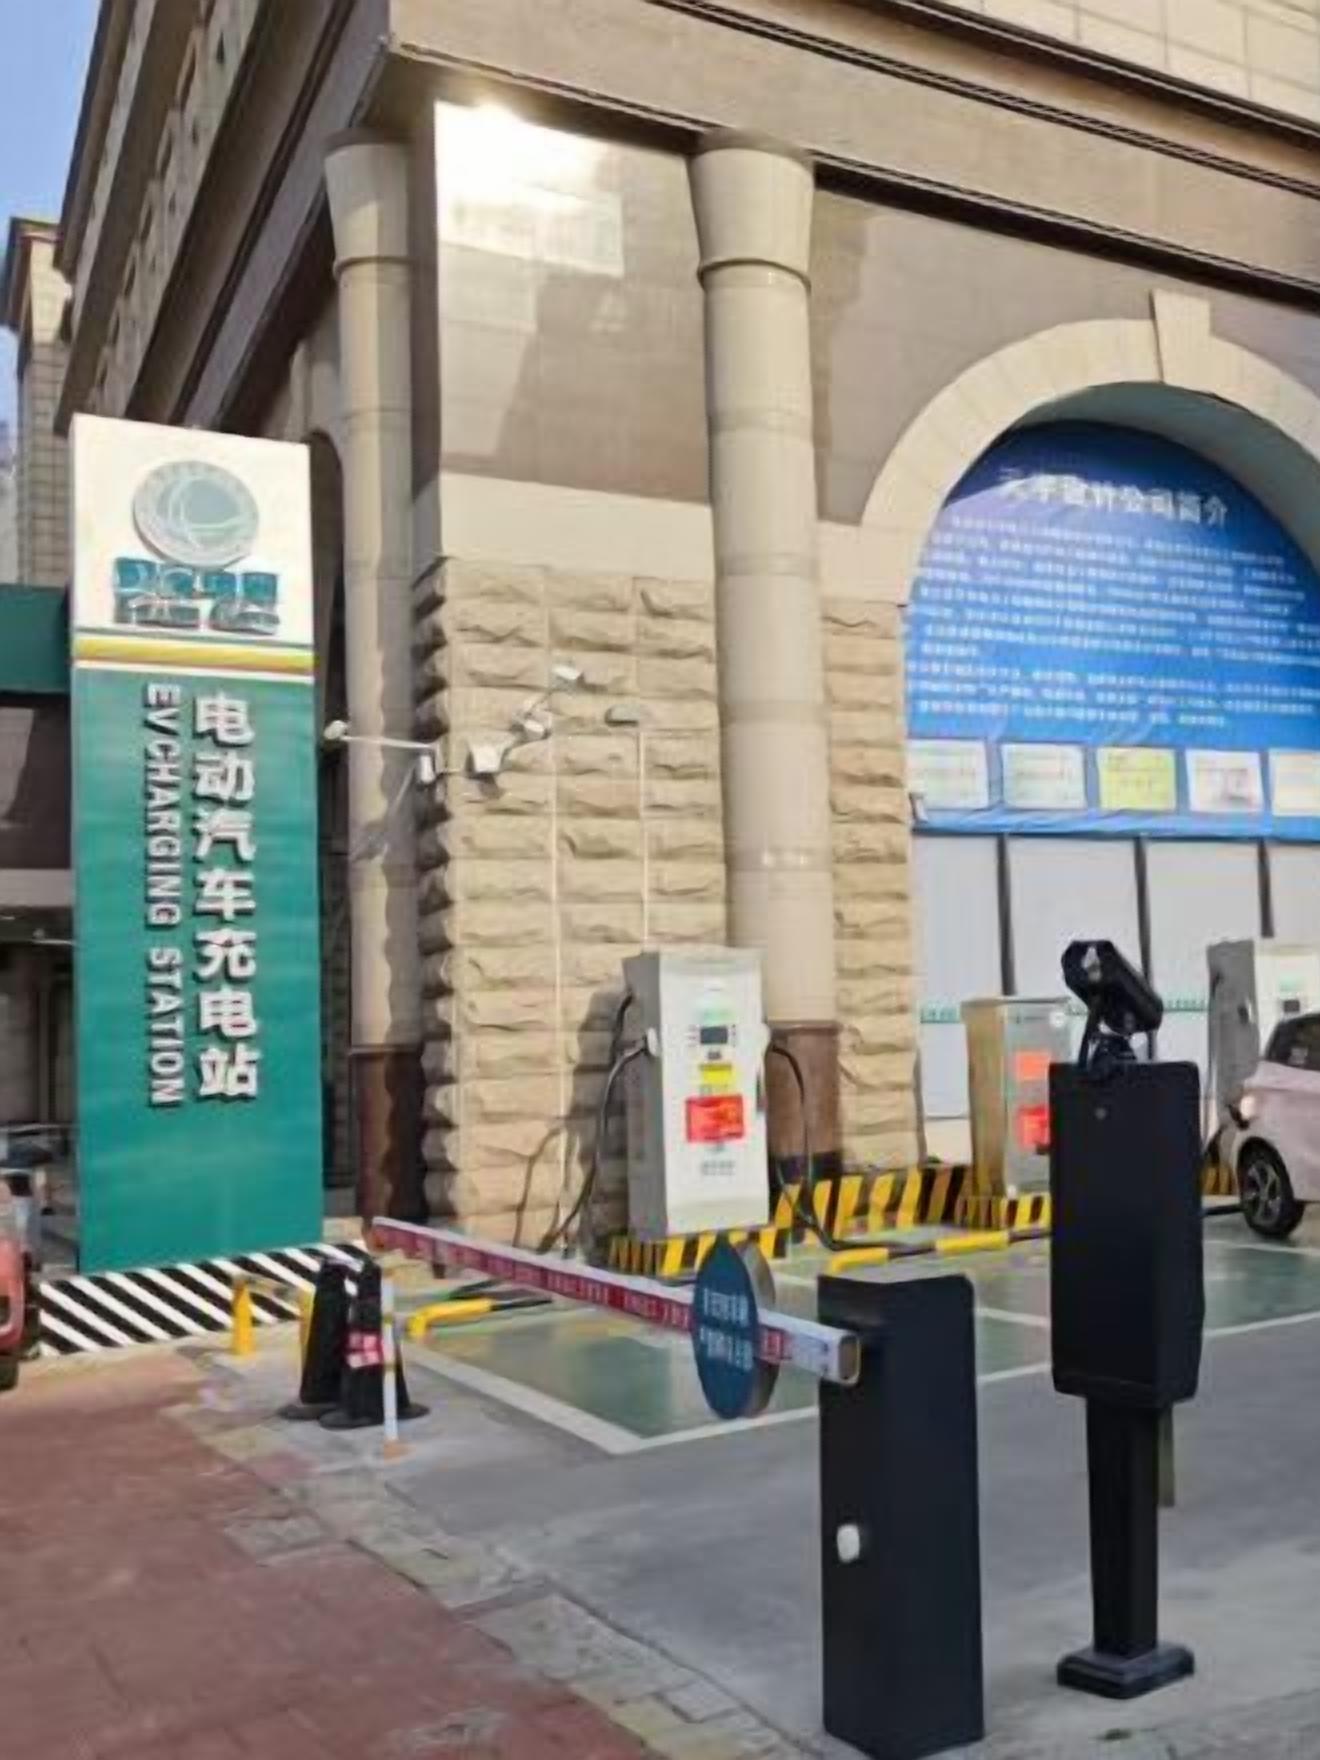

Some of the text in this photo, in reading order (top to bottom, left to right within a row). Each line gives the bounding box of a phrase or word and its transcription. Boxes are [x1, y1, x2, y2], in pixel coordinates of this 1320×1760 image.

[149, 946, 184, 1106] STATION
[194, 693, 261, 1098] 电动汽车充电站
